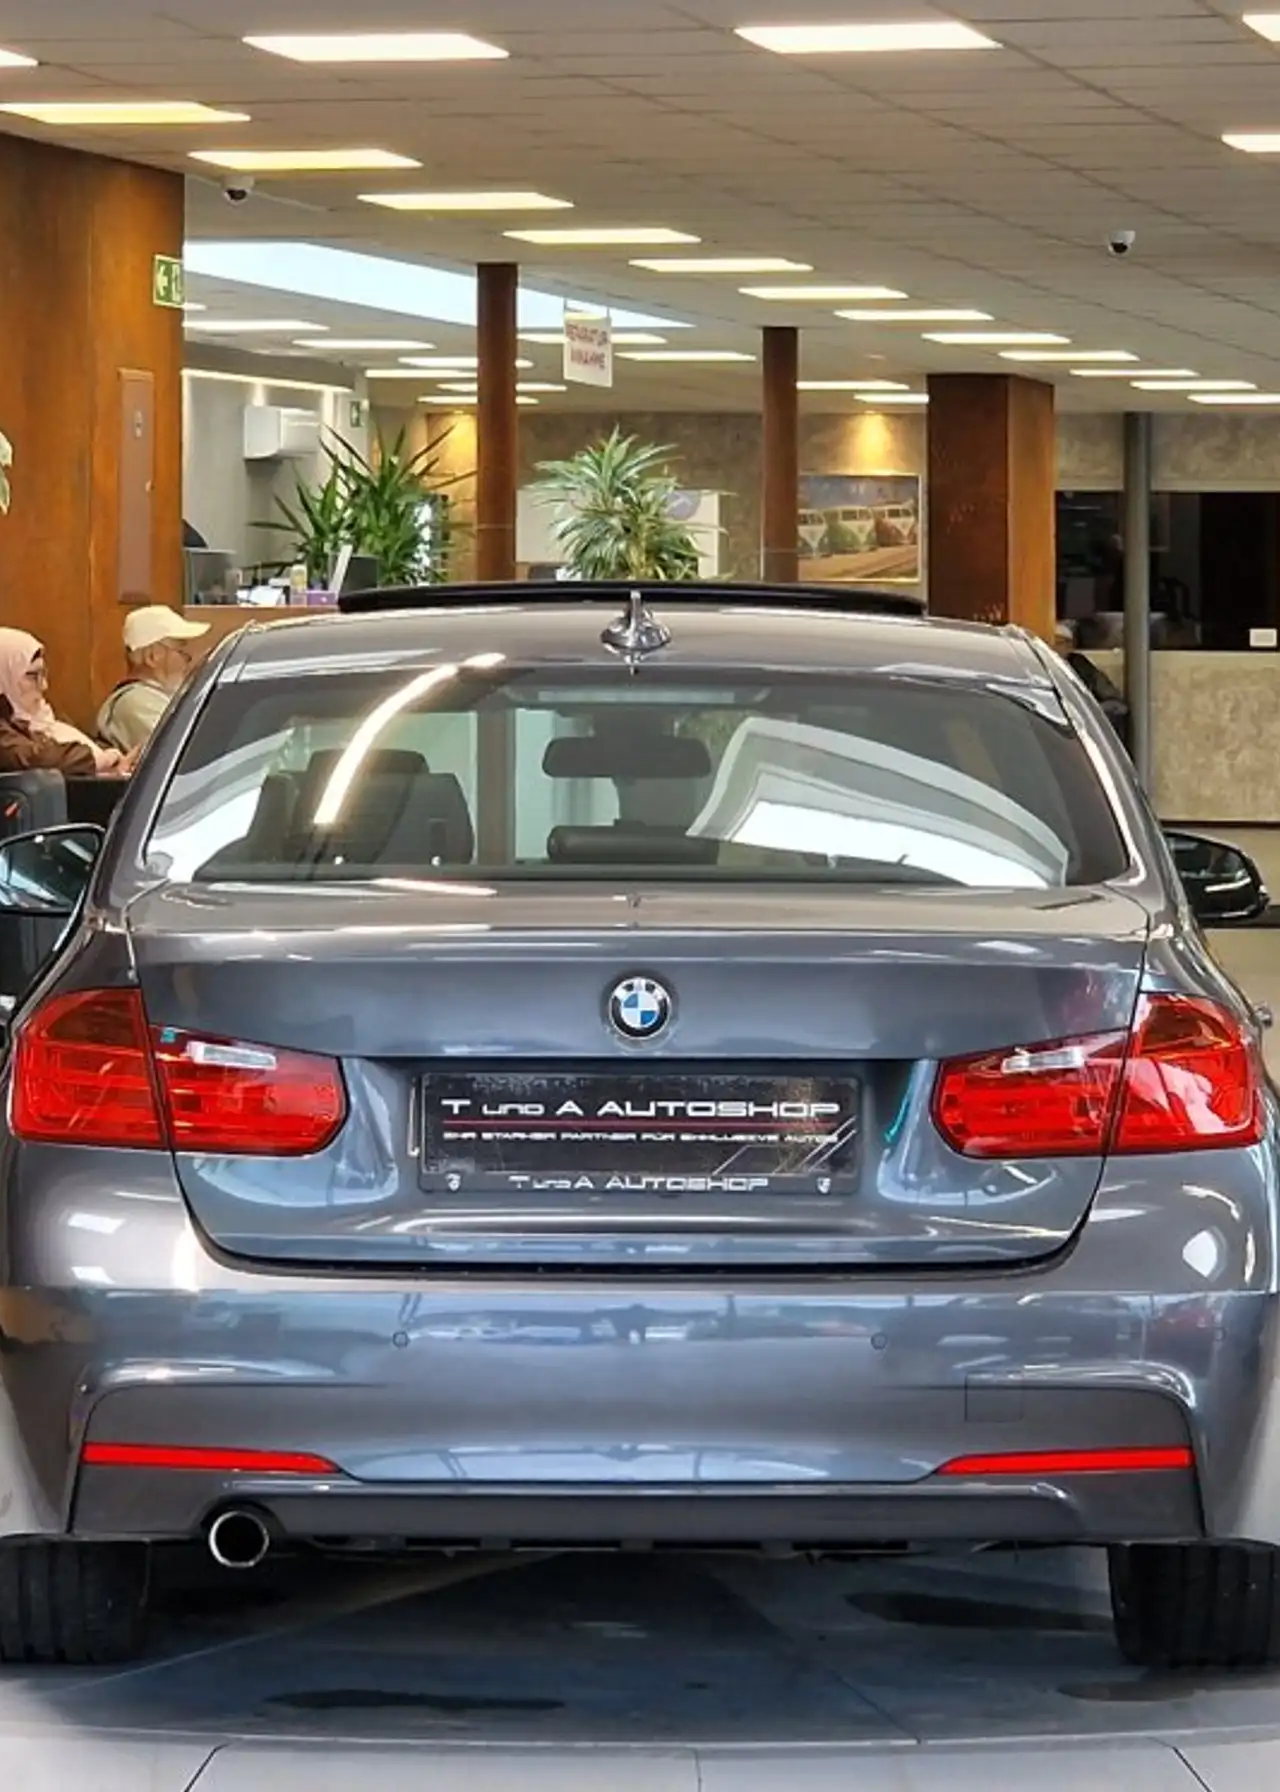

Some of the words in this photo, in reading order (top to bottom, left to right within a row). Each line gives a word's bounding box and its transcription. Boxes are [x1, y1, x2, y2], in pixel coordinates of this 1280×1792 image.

[441, 1100, 472, 1115] T
[555, 1100, 584, 1116] A
[596, 1100, 841, 1118] AUTOSHOP
[560, 1132, 637, 1141] PARTNER
[508, 1175, 531, 1189] T
[573, 1175, 595, 1189] A
[604, 1175, 769, 1191] AUTOSHOP
